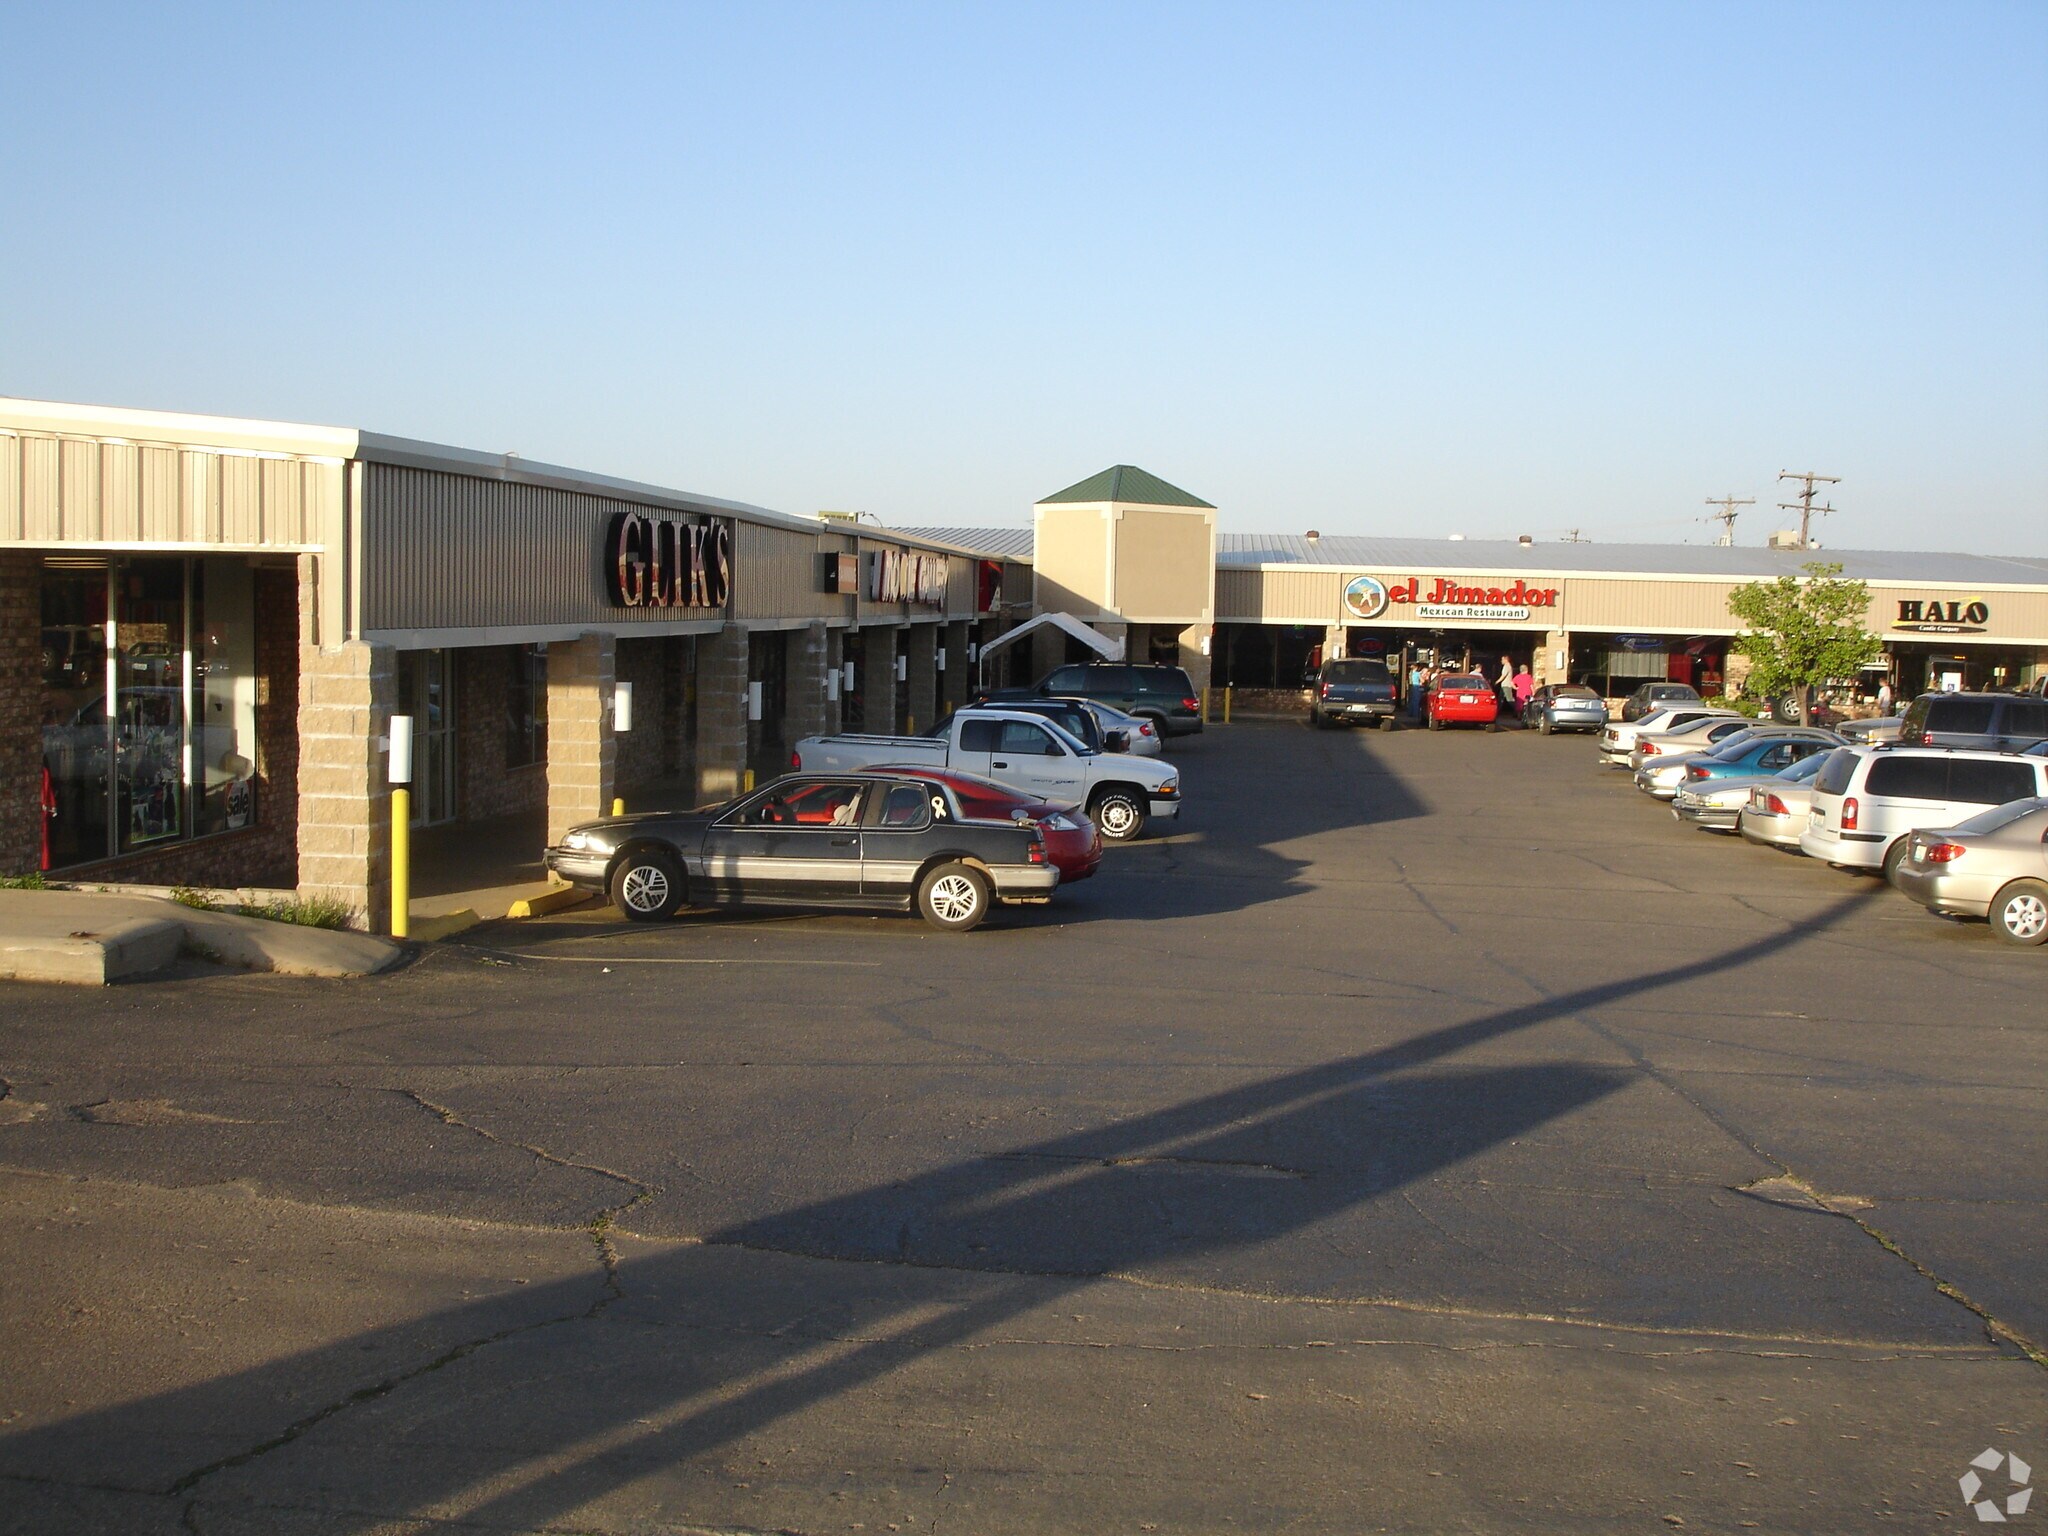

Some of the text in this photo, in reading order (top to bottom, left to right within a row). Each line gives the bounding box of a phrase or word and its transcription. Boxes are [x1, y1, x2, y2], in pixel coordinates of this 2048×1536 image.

[608, 512, 730, 607] GLIK'S
[1388, 577, 1559, 607] el Jimador
[1420, 606, 1525, 618] Mexican Restaurant
[1897, 600, 1988, 624] HALO
[227, 788, 248, 817] sale
